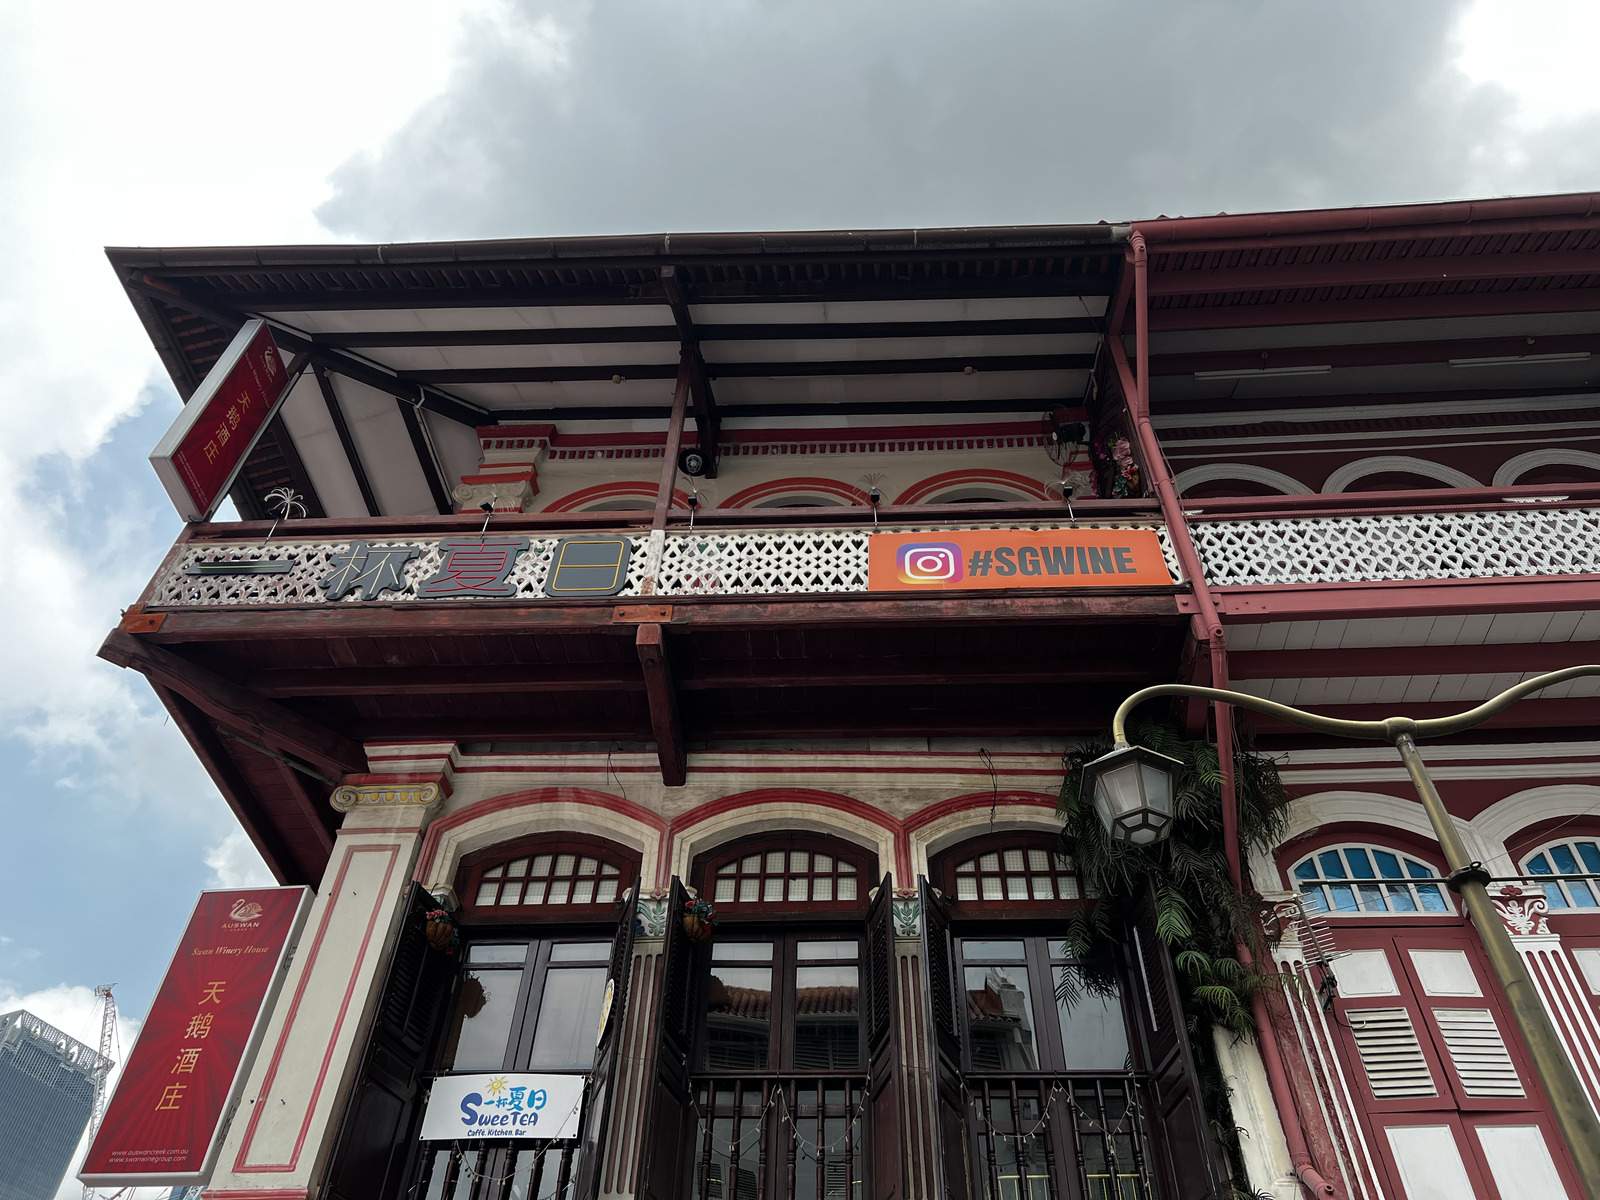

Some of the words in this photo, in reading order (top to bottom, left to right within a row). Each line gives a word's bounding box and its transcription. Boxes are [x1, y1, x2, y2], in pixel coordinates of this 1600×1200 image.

[203, 390, 251, 465] 天鹅酒庄
[968, 546, 1138, 577] #SGWINE
[191, 947, 214, 956] Swan
[215, 946, 243, 957] Winery
[243, 945, 270, 954] House
[155, 980, 226, 1112] 天鹅酒庄
[514, 1128, 527, 1136] Bar
